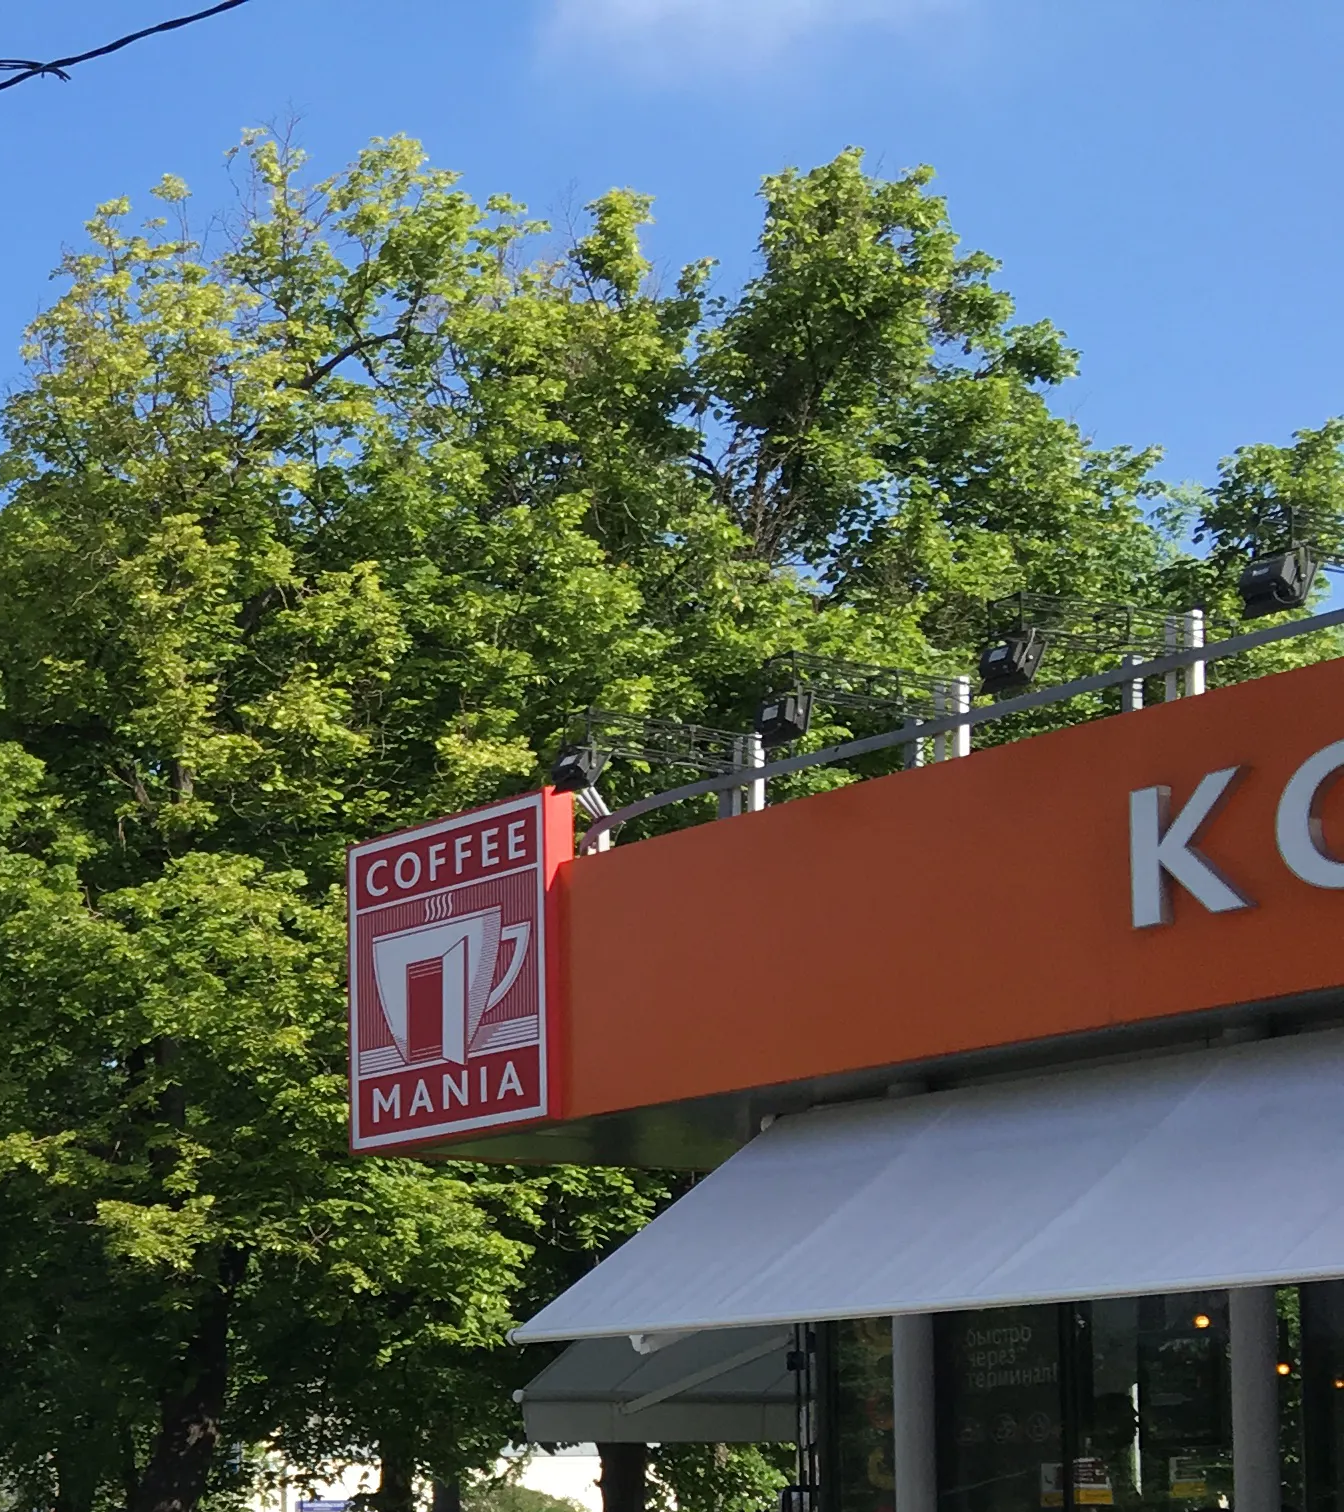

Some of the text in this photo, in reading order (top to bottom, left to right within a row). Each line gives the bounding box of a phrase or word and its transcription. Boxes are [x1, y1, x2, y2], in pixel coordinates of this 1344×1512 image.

[366, 820, 526, 897] COFFEE
[372, 1061, 524, 1123] MANIA
[967, 1325, 1032, 1348] быстро
[968, 1349, 1016, 1371] через
[965, 1362, 1058, 1392] терминал!
